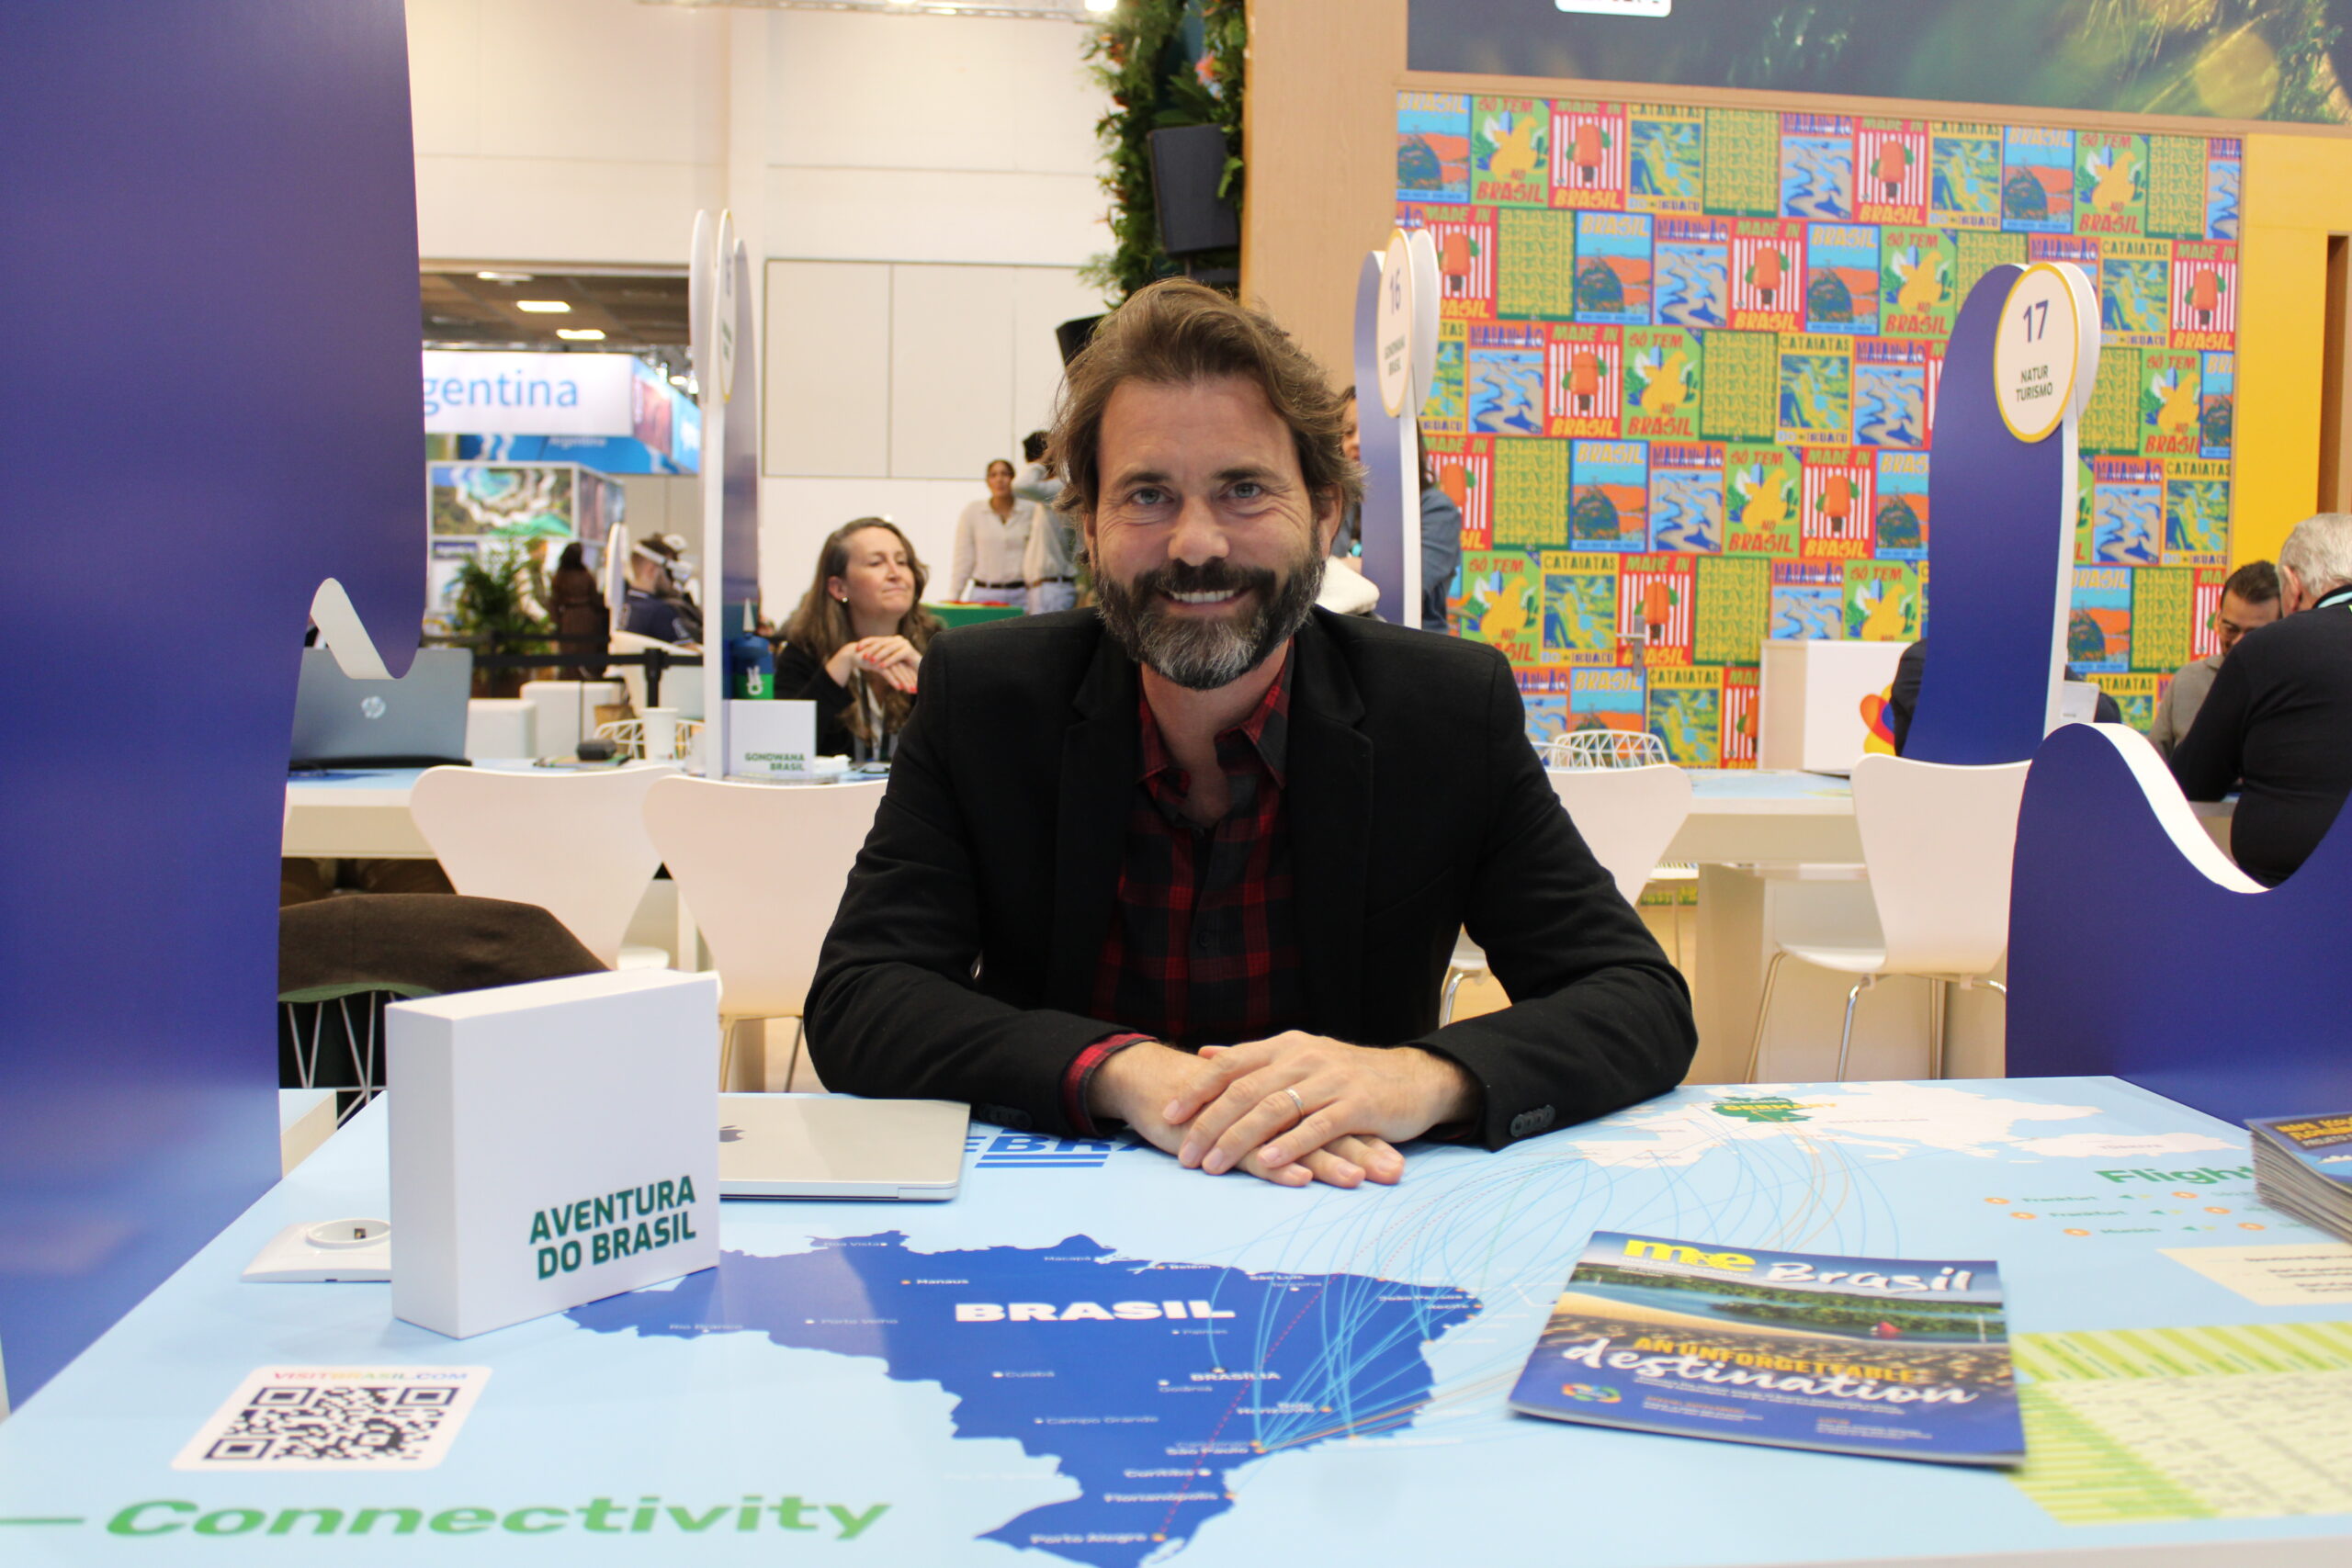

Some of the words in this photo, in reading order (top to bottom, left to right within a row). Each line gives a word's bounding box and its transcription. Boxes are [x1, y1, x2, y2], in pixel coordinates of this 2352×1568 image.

[1397, 92, 1467, 114] BRASIL
[1502, 98, 1533, 114] TEM
[1555, 101, 1599, 115] MADE
[1608, 103, 1623, 115] IN
[1862, 117, 1903, 130] MADE
[1911, 119, 1924, 132] IN
[2007, 126, 2071, 148] BRASIL
[2103, 134, 2132, 149] TEM
[1476, 181, 1544, 203] BRASIL
[1554, 188, 1622, 209] BRASIL
[1425, 205, 1470, 222] MADE
[1476, 207, 1491, 223] IN
[1860, 205, 1922, 225] BRASIL
[2078, 213, 2141, 234] BRASIL
[1579, 213, 1651, 237] BRASIL
[1736, 220, 1781, 238] MADE
[1786, 223, 1801, 238] IN
[1811, 226, 1878, 248] BRASIL
[1909, 233, 1939, 248] TEM
[2177, 243, 2217, 260] MADE
[2222, 245, 2236, 261] IN
[1440, 299, 1490, 318] RASIL
[1735, 311, 1798, 332] BRASIL
[1885, 314, 1949, 335] BRASIL
[2023, 299, 2049, 344] 17
[1553, 325, 1598, 343] MADE
[1603, 326, 1619, 343] IN
[1651, 333, 1683, 348] TEM
[2174, 332, 2233, 350] BRASIL
[2168, 356, 2197, 370] TEM
[2020, 365, 2049, 384] NATUR
[424, 370, 579, 417] gentina
[2016, 382, 2053, 402] TURISMO
[1551, 417, 1617, 437] BRASIL
[1627, 416, 1694, 437] BRASIL
[1424, 436, 1467, 453] MADE
[1472, 437, 1487, 454] IN
[1576, 442, 1645, 465] BRASIL
[1752, 449, 1784, 467] TEM
[1806, 449, 1850, 467] MADE
[1855, 450, 1871, 467] IN
[1880, 453, 1928, 475] BRAS
[1727, 532, 1793, 553] BRASIL
[1804, 539, 1868, 559] BRASIL
[1492, 557, 1525, 573] TEM
[1625, 556, 1670, 571] MADE
[1674, 557, 1690, 572] IN
[1872, 566, 1903, 582] TEM
[1622, 646, 1688, 666] BASIL
[770, 762, 806, 772] BRASIL
[529, 1175, 696, 1246] AVENTURA
[537, 1240, 582, 1280] DO
[593, 1211, 696, 1266] BRASIL
[915, 1278, 970, 1286] Manaus
[1766, 1262, 1974, 1295] Brasil
[955, 1300, 1237, 1322] BRASIL
[1634, 1336, 1677, 1355] AN
[1562, 1337, 1980, 1405] destination
[105, 1495, 894, 1540] Connectivity
[1030, 1533, 1084, 1545] Porto
[1086, 1531, 1148, 1544] Alegre
